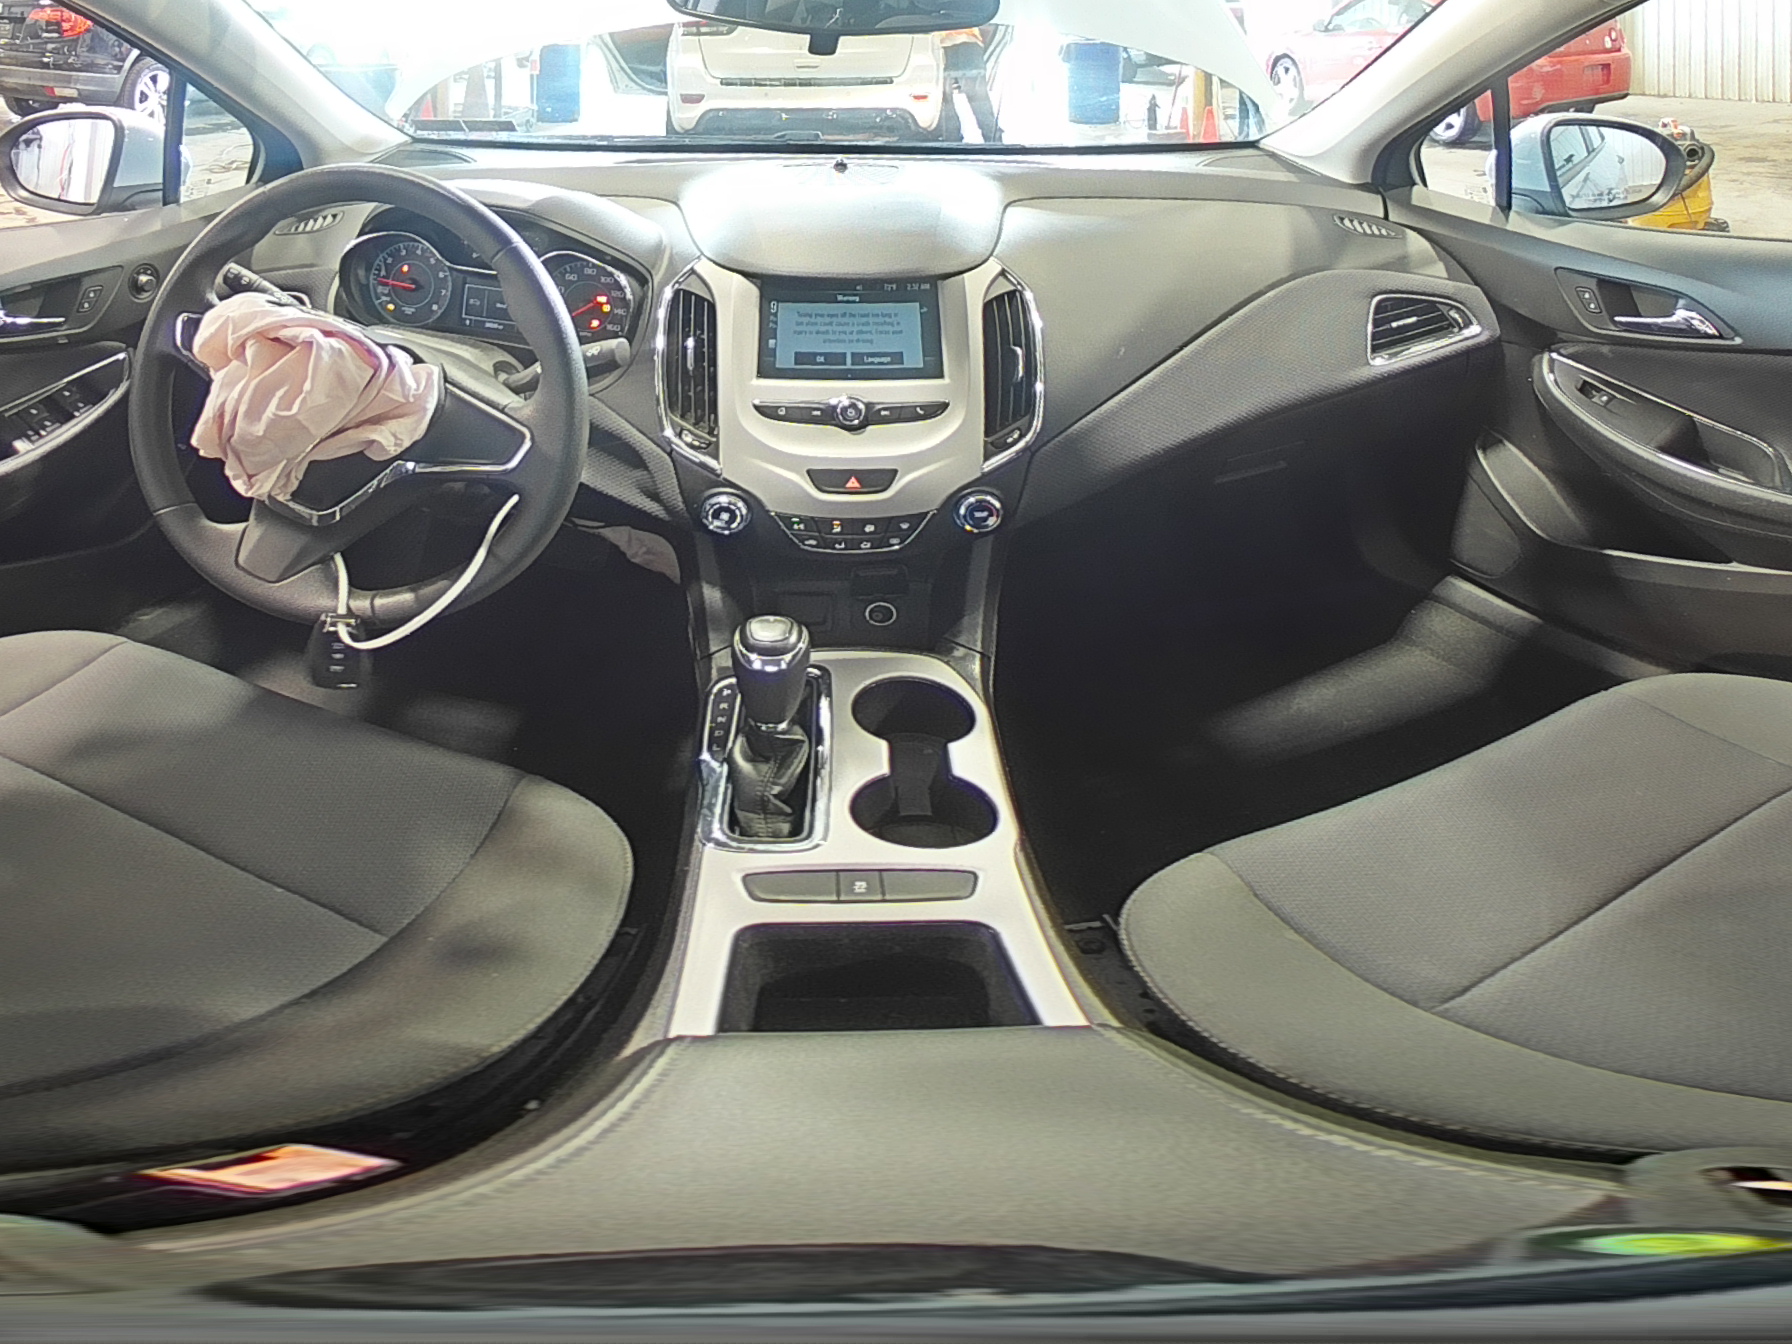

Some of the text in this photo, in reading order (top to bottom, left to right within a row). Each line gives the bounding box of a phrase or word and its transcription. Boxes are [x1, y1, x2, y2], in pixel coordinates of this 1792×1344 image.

[584, 267, 597, 275] 80
[565, 273, 578, 281] 60
[600, 276, 615, 284] 100
[610, 290, 625, 298] 120
[614, 308, 627, 316] 140
[606, 324, 621, 332] 160
